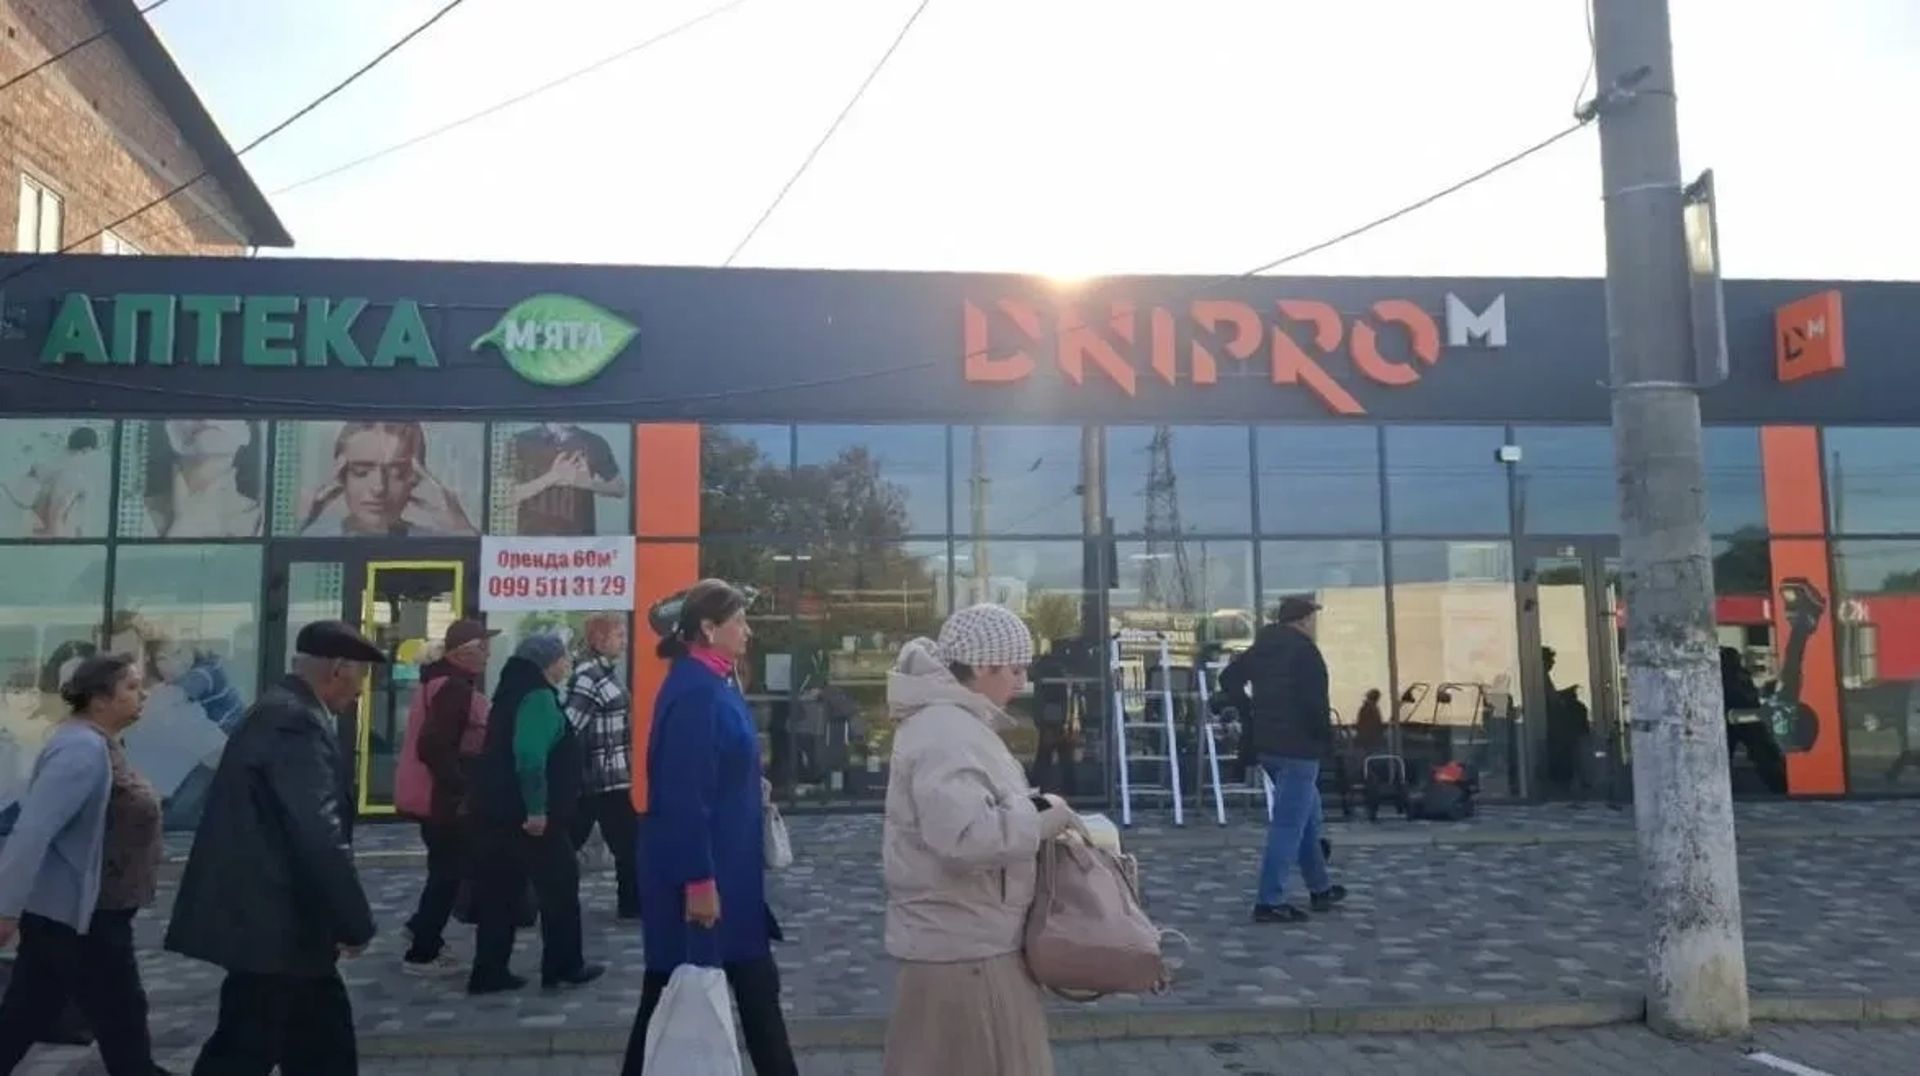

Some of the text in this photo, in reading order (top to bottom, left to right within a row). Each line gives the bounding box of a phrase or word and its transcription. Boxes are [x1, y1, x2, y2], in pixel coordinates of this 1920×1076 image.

[41, 293, 440, 368] АПТЕКА
[963, 298, 1440, 415] DNIPRO
[497, 550, 570, 570] Оренда
[489, 574, 626, 598] 099 511 31 29
